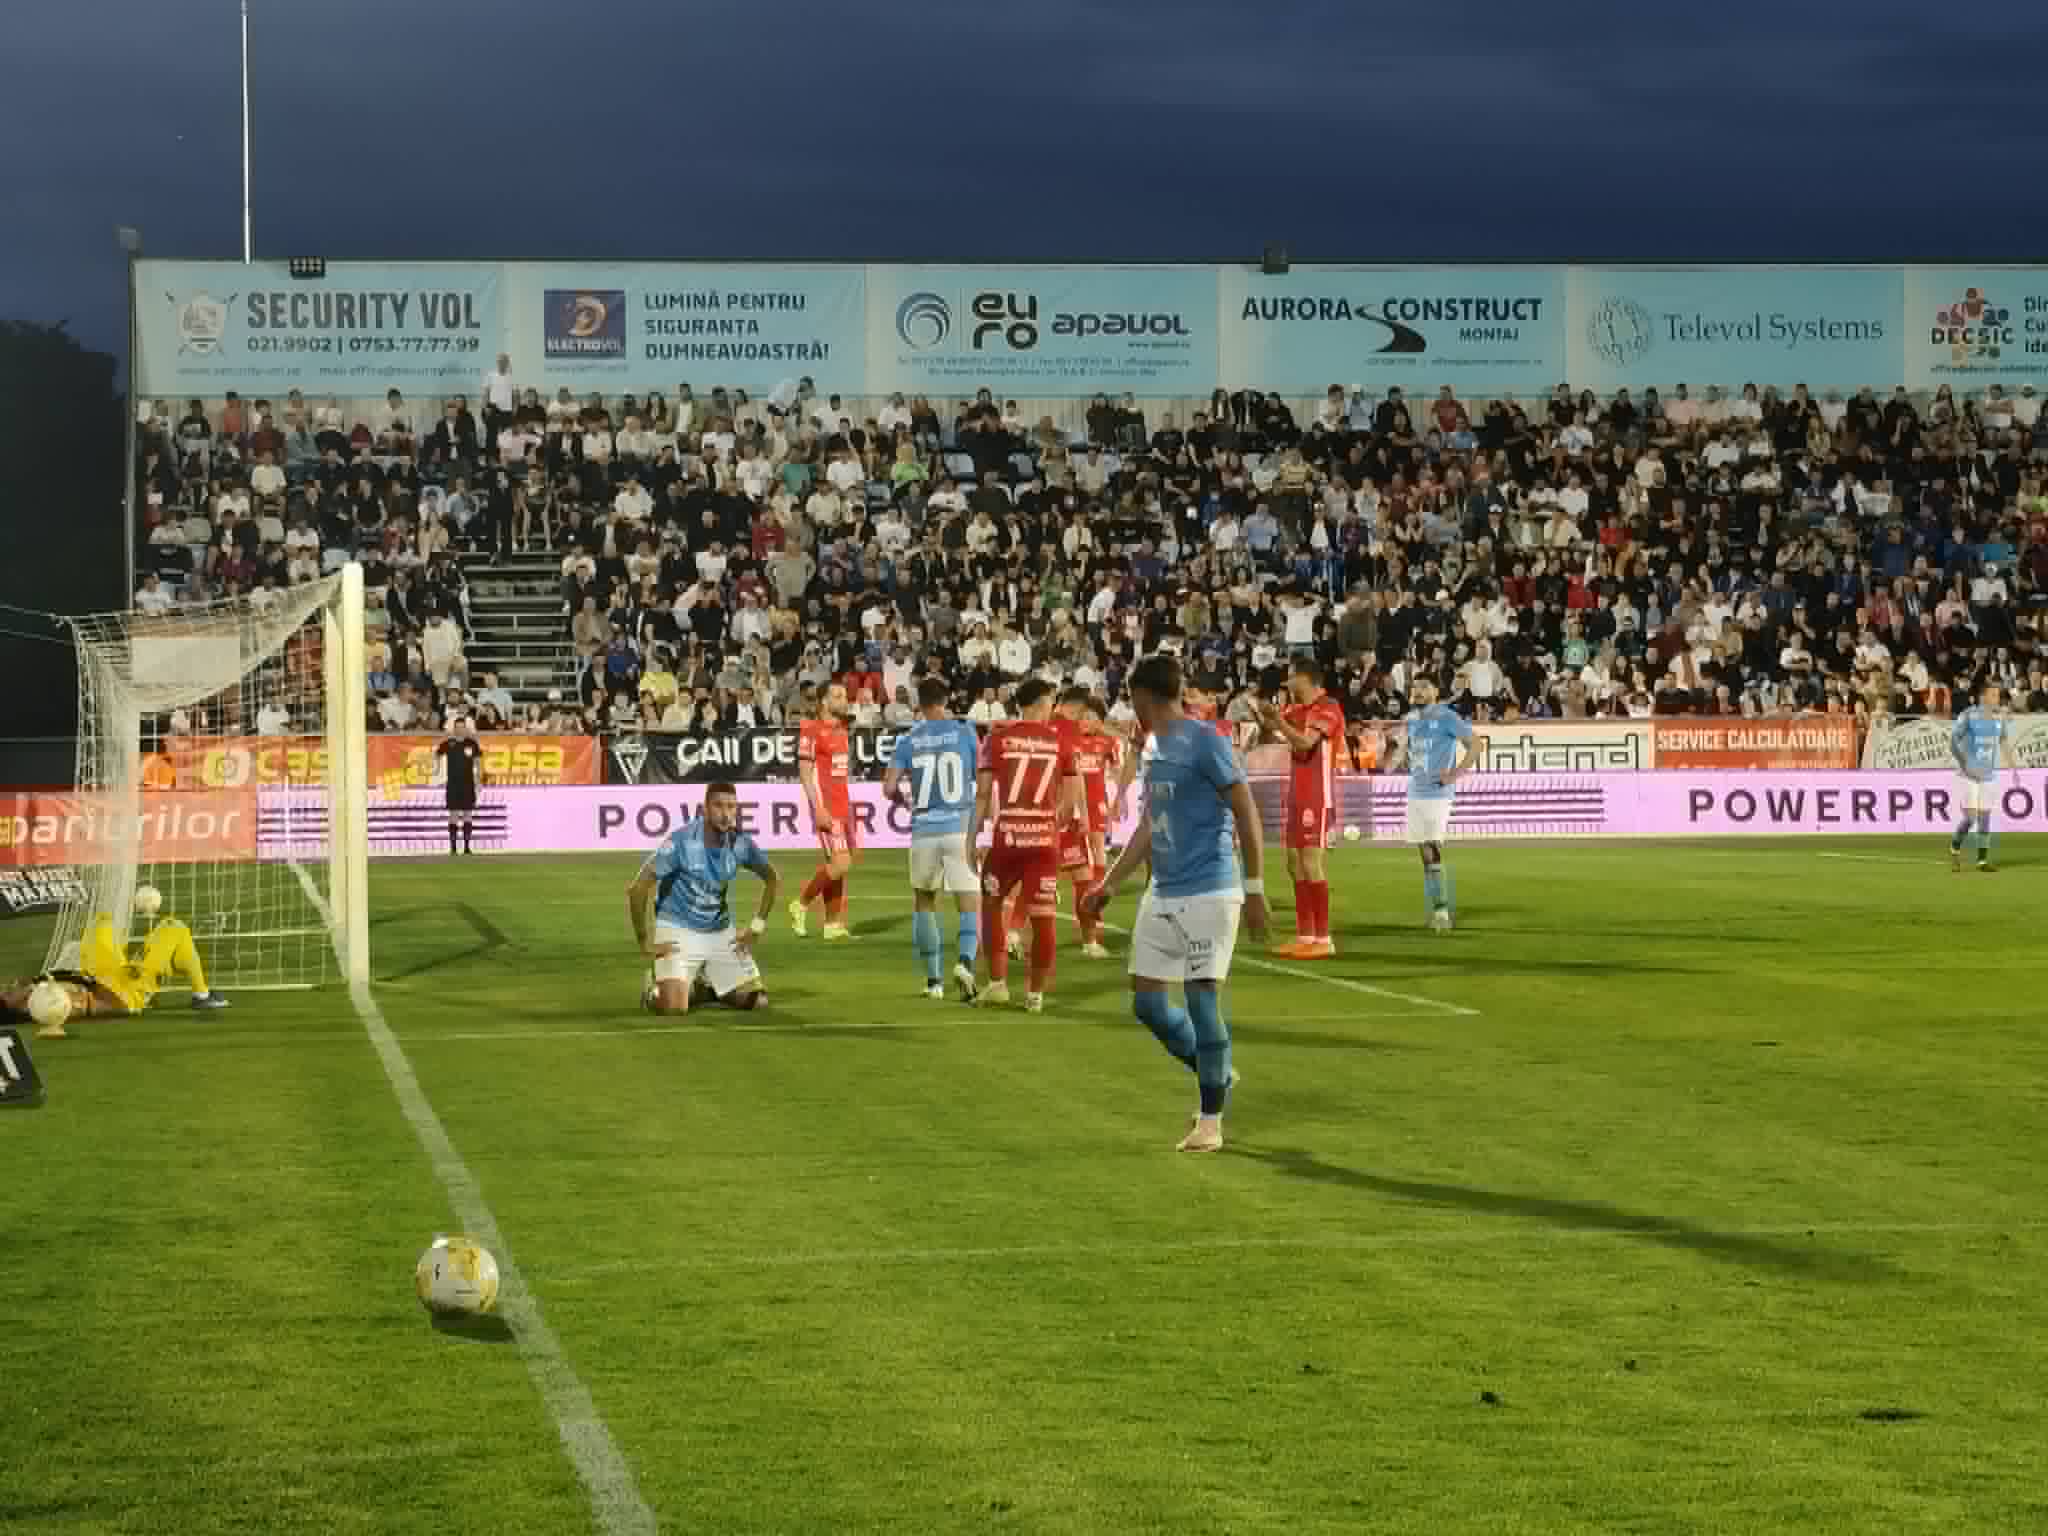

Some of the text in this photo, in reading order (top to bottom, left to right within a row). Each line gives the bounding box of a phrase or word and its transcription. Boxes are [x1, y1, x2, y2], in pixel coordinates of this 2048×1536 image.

[247, 293, 481, 329] SECURITY VOL
[728, 293, 806, 311] PENTRU
[1242, 298, 1542, 321] AURORA CONSTRUCT
[1458, 327, 1519, 342] MONTAJ
[1664, 313, 1883, 348] Televol Systems
[1931, 328, 2014, 345] DECSIC
[752, 737, 796, 764] DE
[1656, 728, 1849, 750] SERVICE CALCULATOARE
[484, 746, 562, 772] asa
[912, 752, 961, 807] 70
[1000, 752, 1056, 804] 77
[598, 803, 912, 838] POERRO
